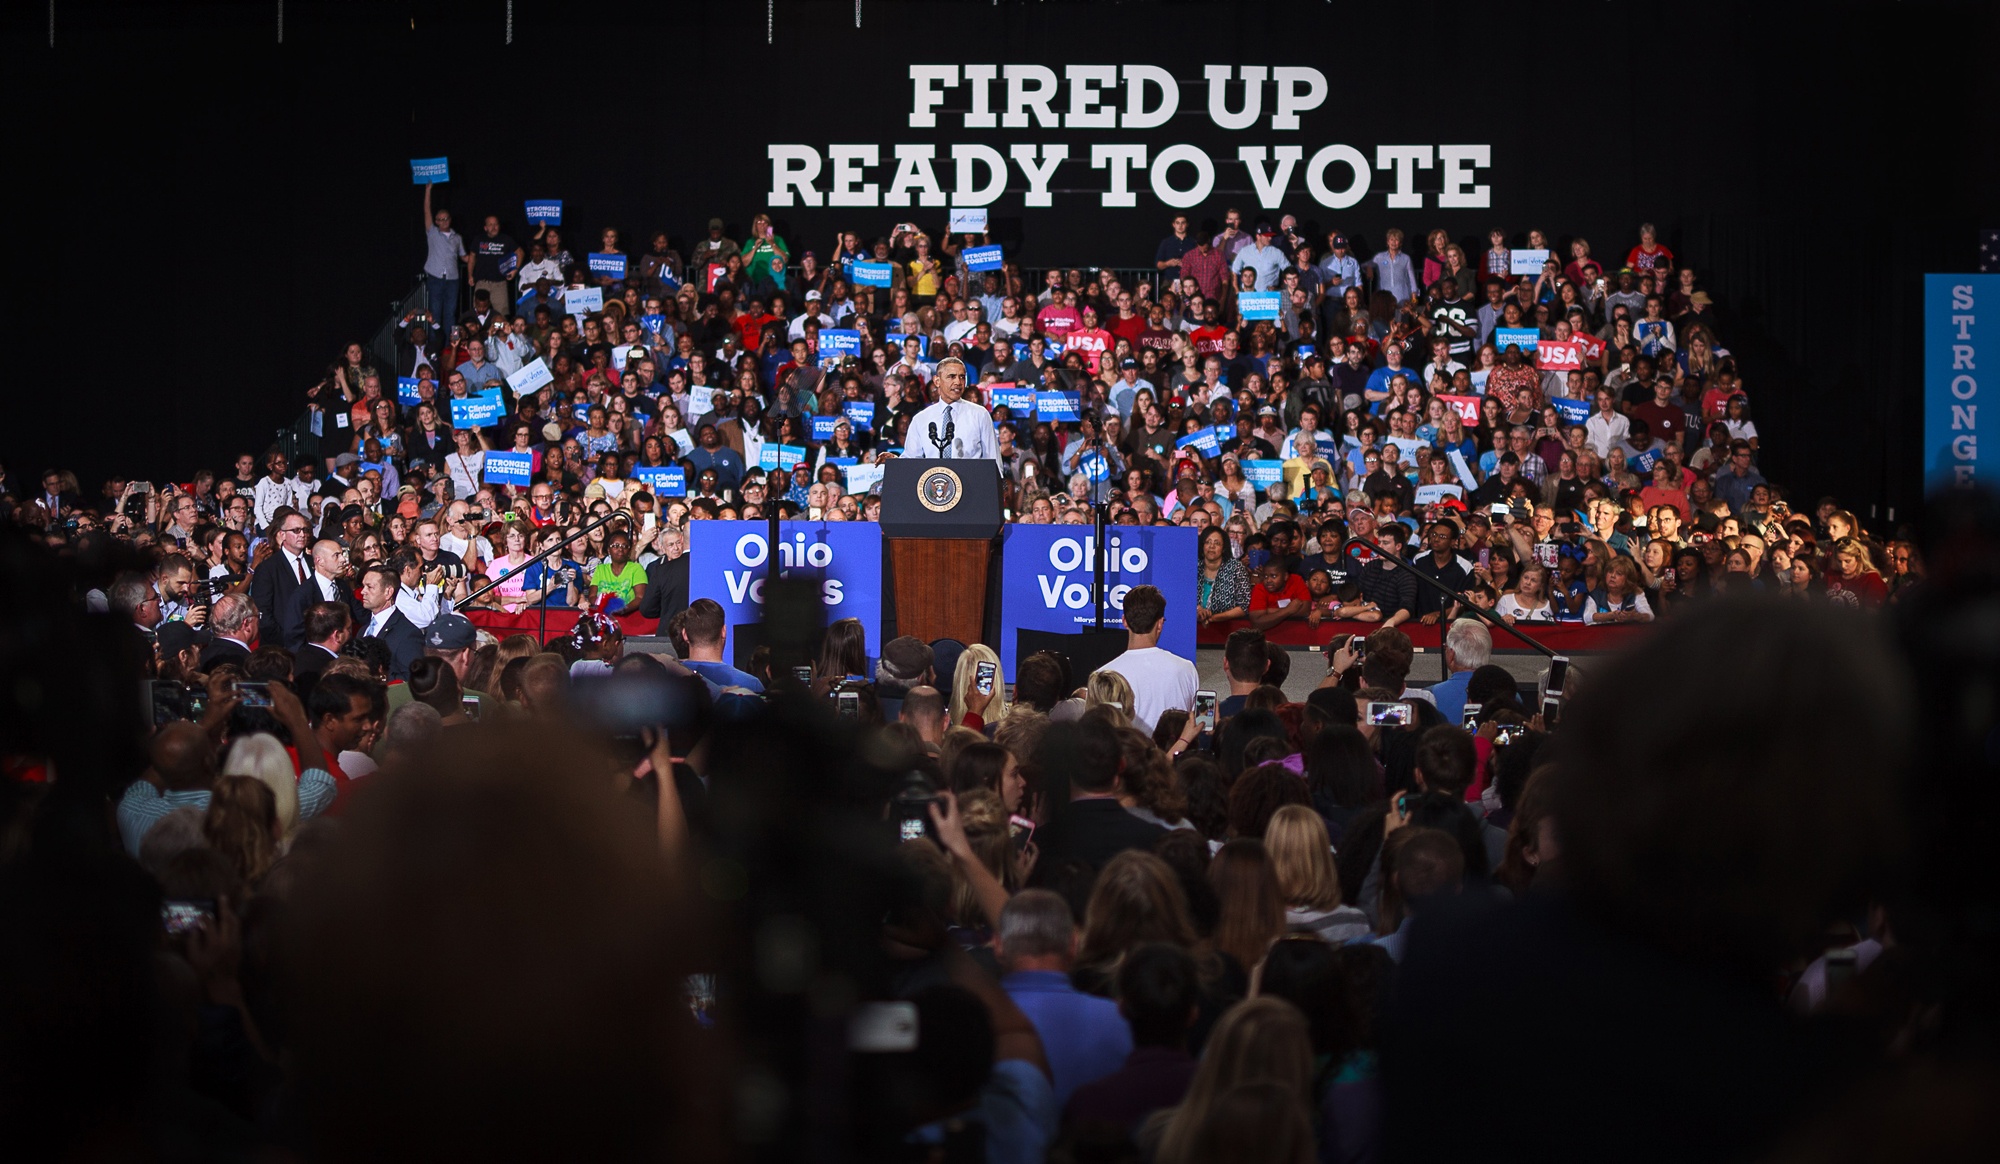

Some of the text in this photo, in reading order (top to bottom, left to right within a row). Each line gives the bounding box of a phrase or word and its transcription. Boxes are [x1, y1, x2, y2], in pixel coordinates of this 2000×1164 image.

[908, 64, 1328, 130] FIRED UP
[413, 164, 446, 172] STRONGER
[767, 144, 1491, 209] READY TO VOTE
[964, 250, 1000, 260] STRONGER
[965, 256, 1002, 264] TOGETHER
[854, 267, 890, 275] STRONGER
[834, 334, 859, 343] Clinton
[1067, 336, 1106, 352] USA
[1538, 346, 1580, 364] USA
[517, 379, 528, 388] will
[468, 404, 496, 413] Clinton
[1563, 406, 1588, 415] Clinton
[468, 411, 491, 420] Kaine
[1563, 412, 1583, 421] Kaine
[762, 450, 802, 459] STRONGER
[487, 459, 530, 469] STRONGER
[487, 466, 529, 476] TOGETHER
